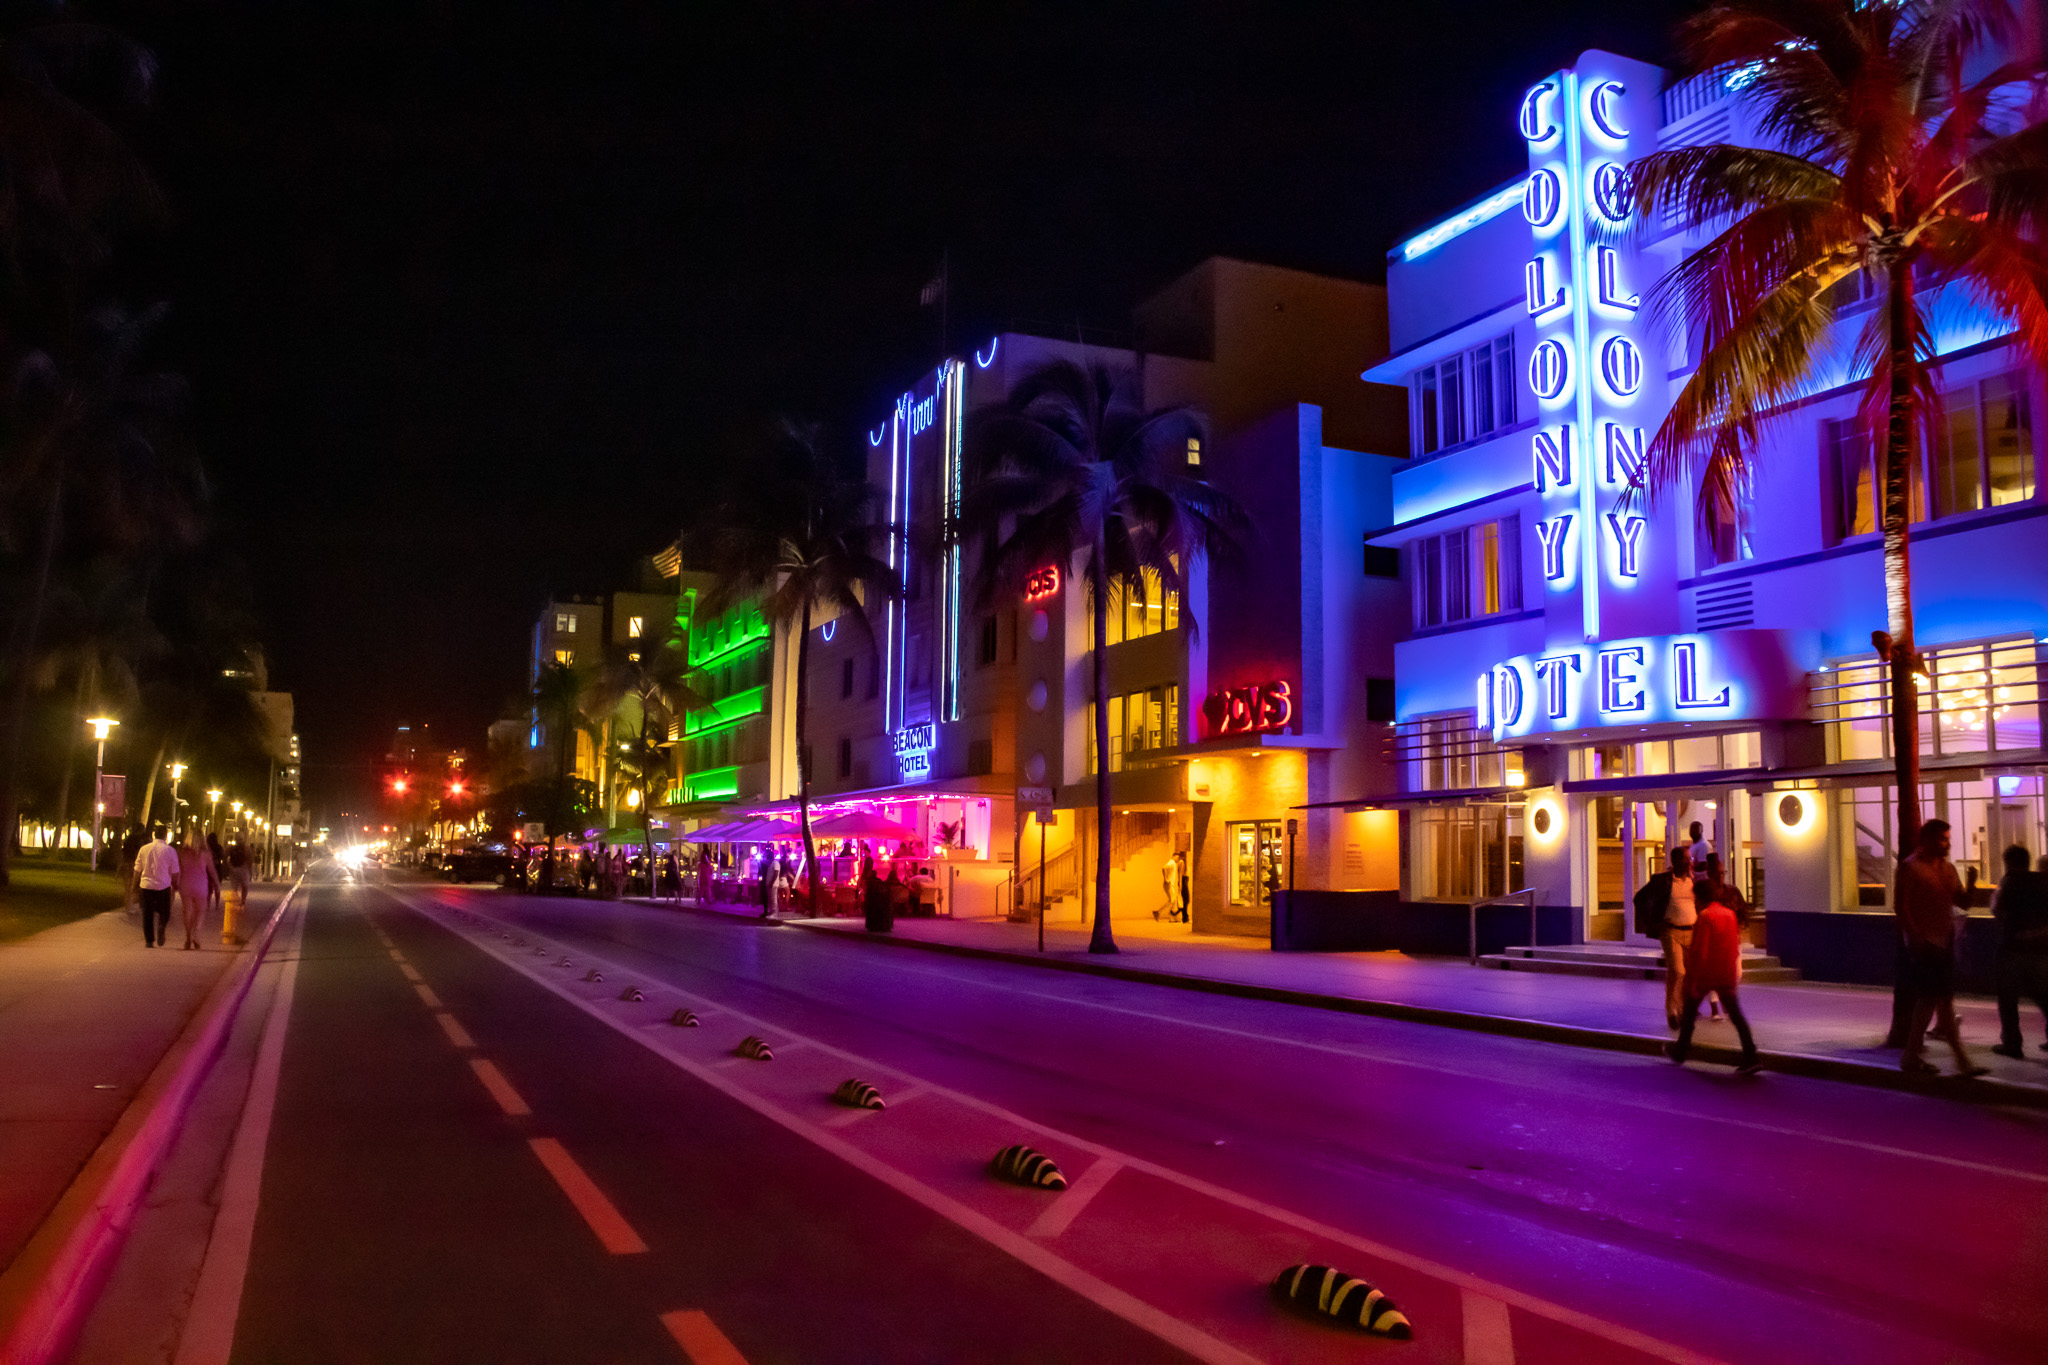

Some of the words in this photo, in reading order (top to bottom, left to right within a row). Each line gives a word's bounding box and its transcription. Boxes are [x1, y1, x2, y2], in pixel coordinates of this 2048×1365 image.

[1520, 83, 1573, 580] COLONY
[1591, 80, 1647, 578] COLONY
[1226, 681, 1292, 732] CVS
[893, 725, 932, 752] BEACON
[899, 755, 928, 773] HOTEL
